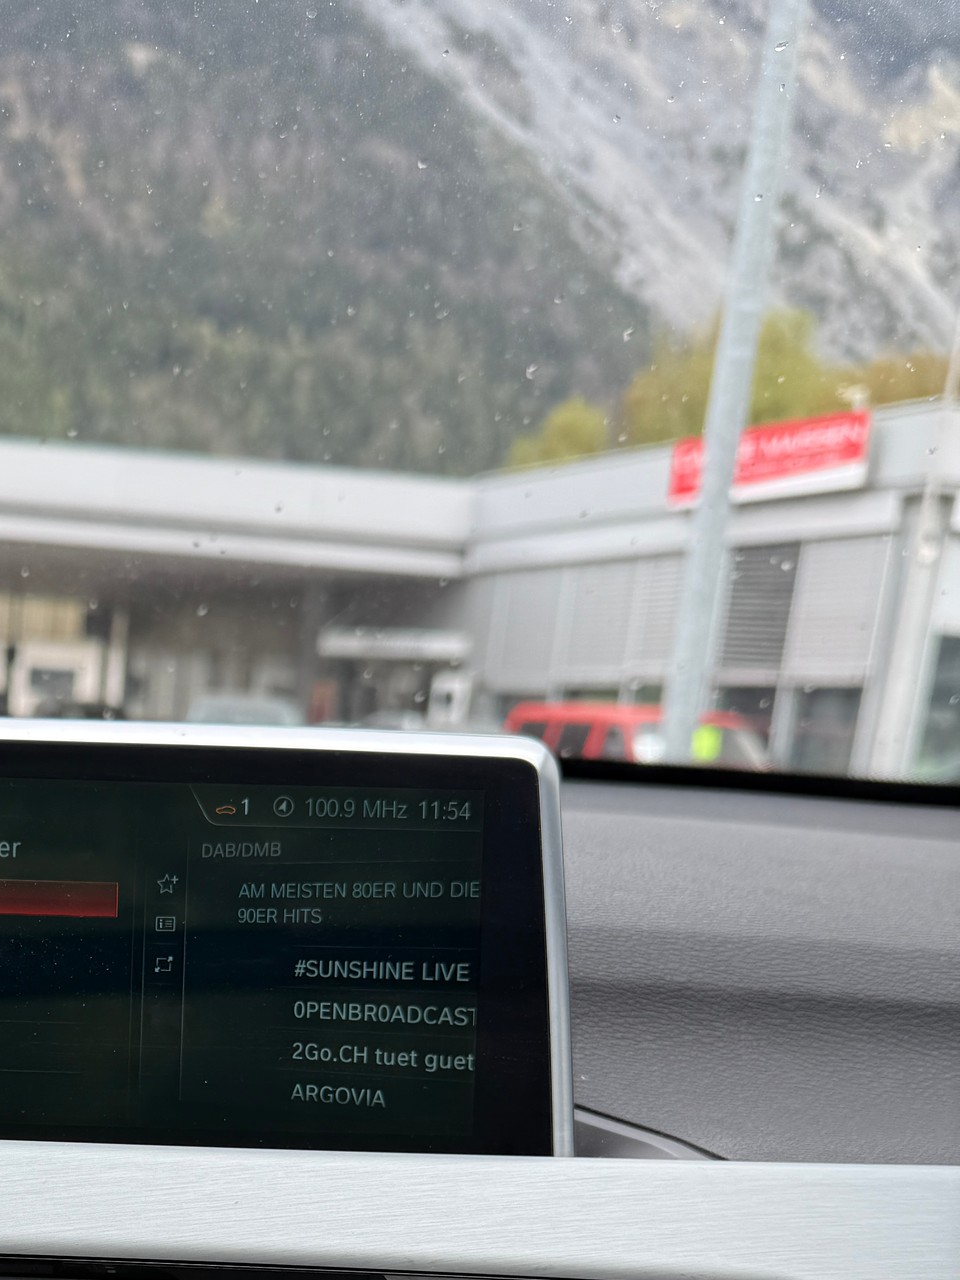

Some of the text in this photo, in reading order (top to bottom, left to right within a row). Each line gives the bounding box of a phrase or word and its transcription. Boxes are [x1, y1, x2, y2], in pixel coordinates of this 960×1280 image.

[241, 799, 249, 815] 1
[305, 799, 407, 819] 100.9 MHz
[419, 802, 471, 821] 11:54
[202, 843, 282, 858] DAB/DMB
[239, 882, 480, 898] AM MEISTEN 80ER UND DIE
[238, 908, 321, 924] 90ER HITS
[294, 960, 470, 982] #SUNSHINE LIVE
[292, 1043, 475, 1073] 2Go.CH tuet guet
[291, 1084, 386, 1107] ARGOVIA
